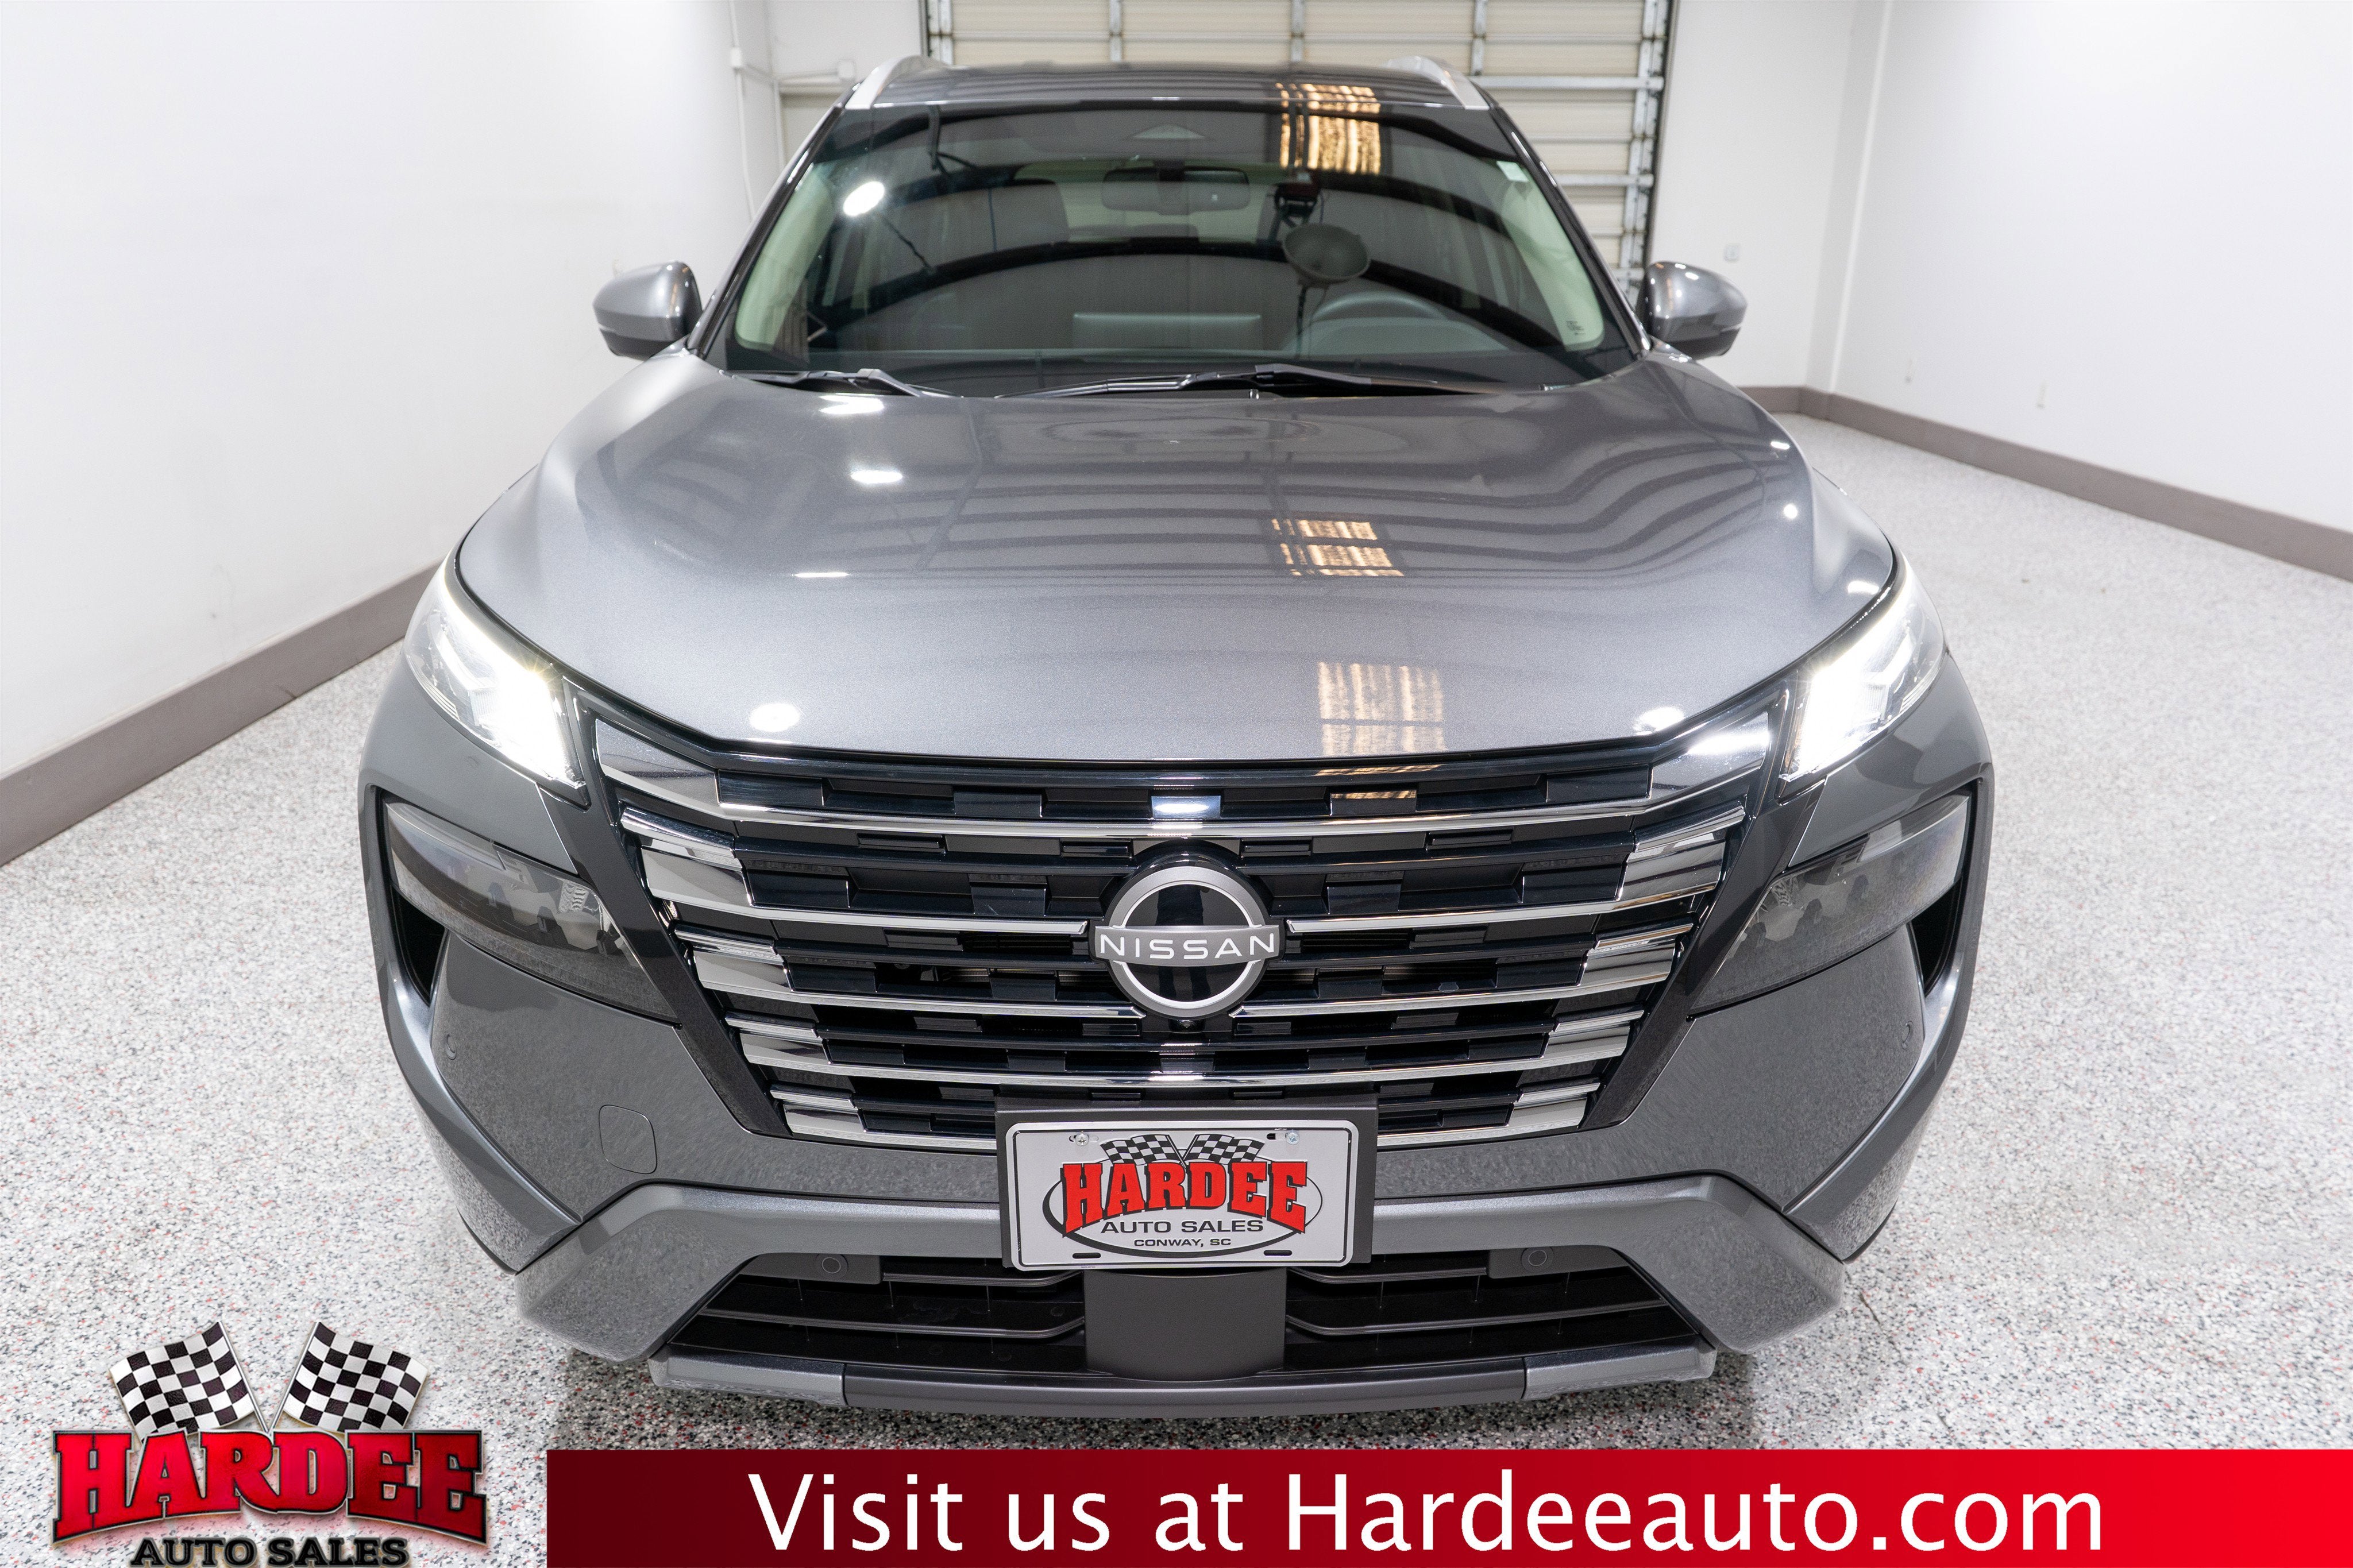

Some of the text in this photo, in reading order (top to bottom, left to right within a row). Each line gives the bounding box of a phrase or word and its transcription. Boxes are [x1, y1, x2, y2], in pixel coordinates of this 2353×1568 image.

[1100, 933, 1275, 960] NISSAN
[1062, 1161, 1307, 1234] HARDEE
[1101, 1220, 1263, 1233] AUTO SALES
[1134, 1238, 1204, 1248] CONWAY,
